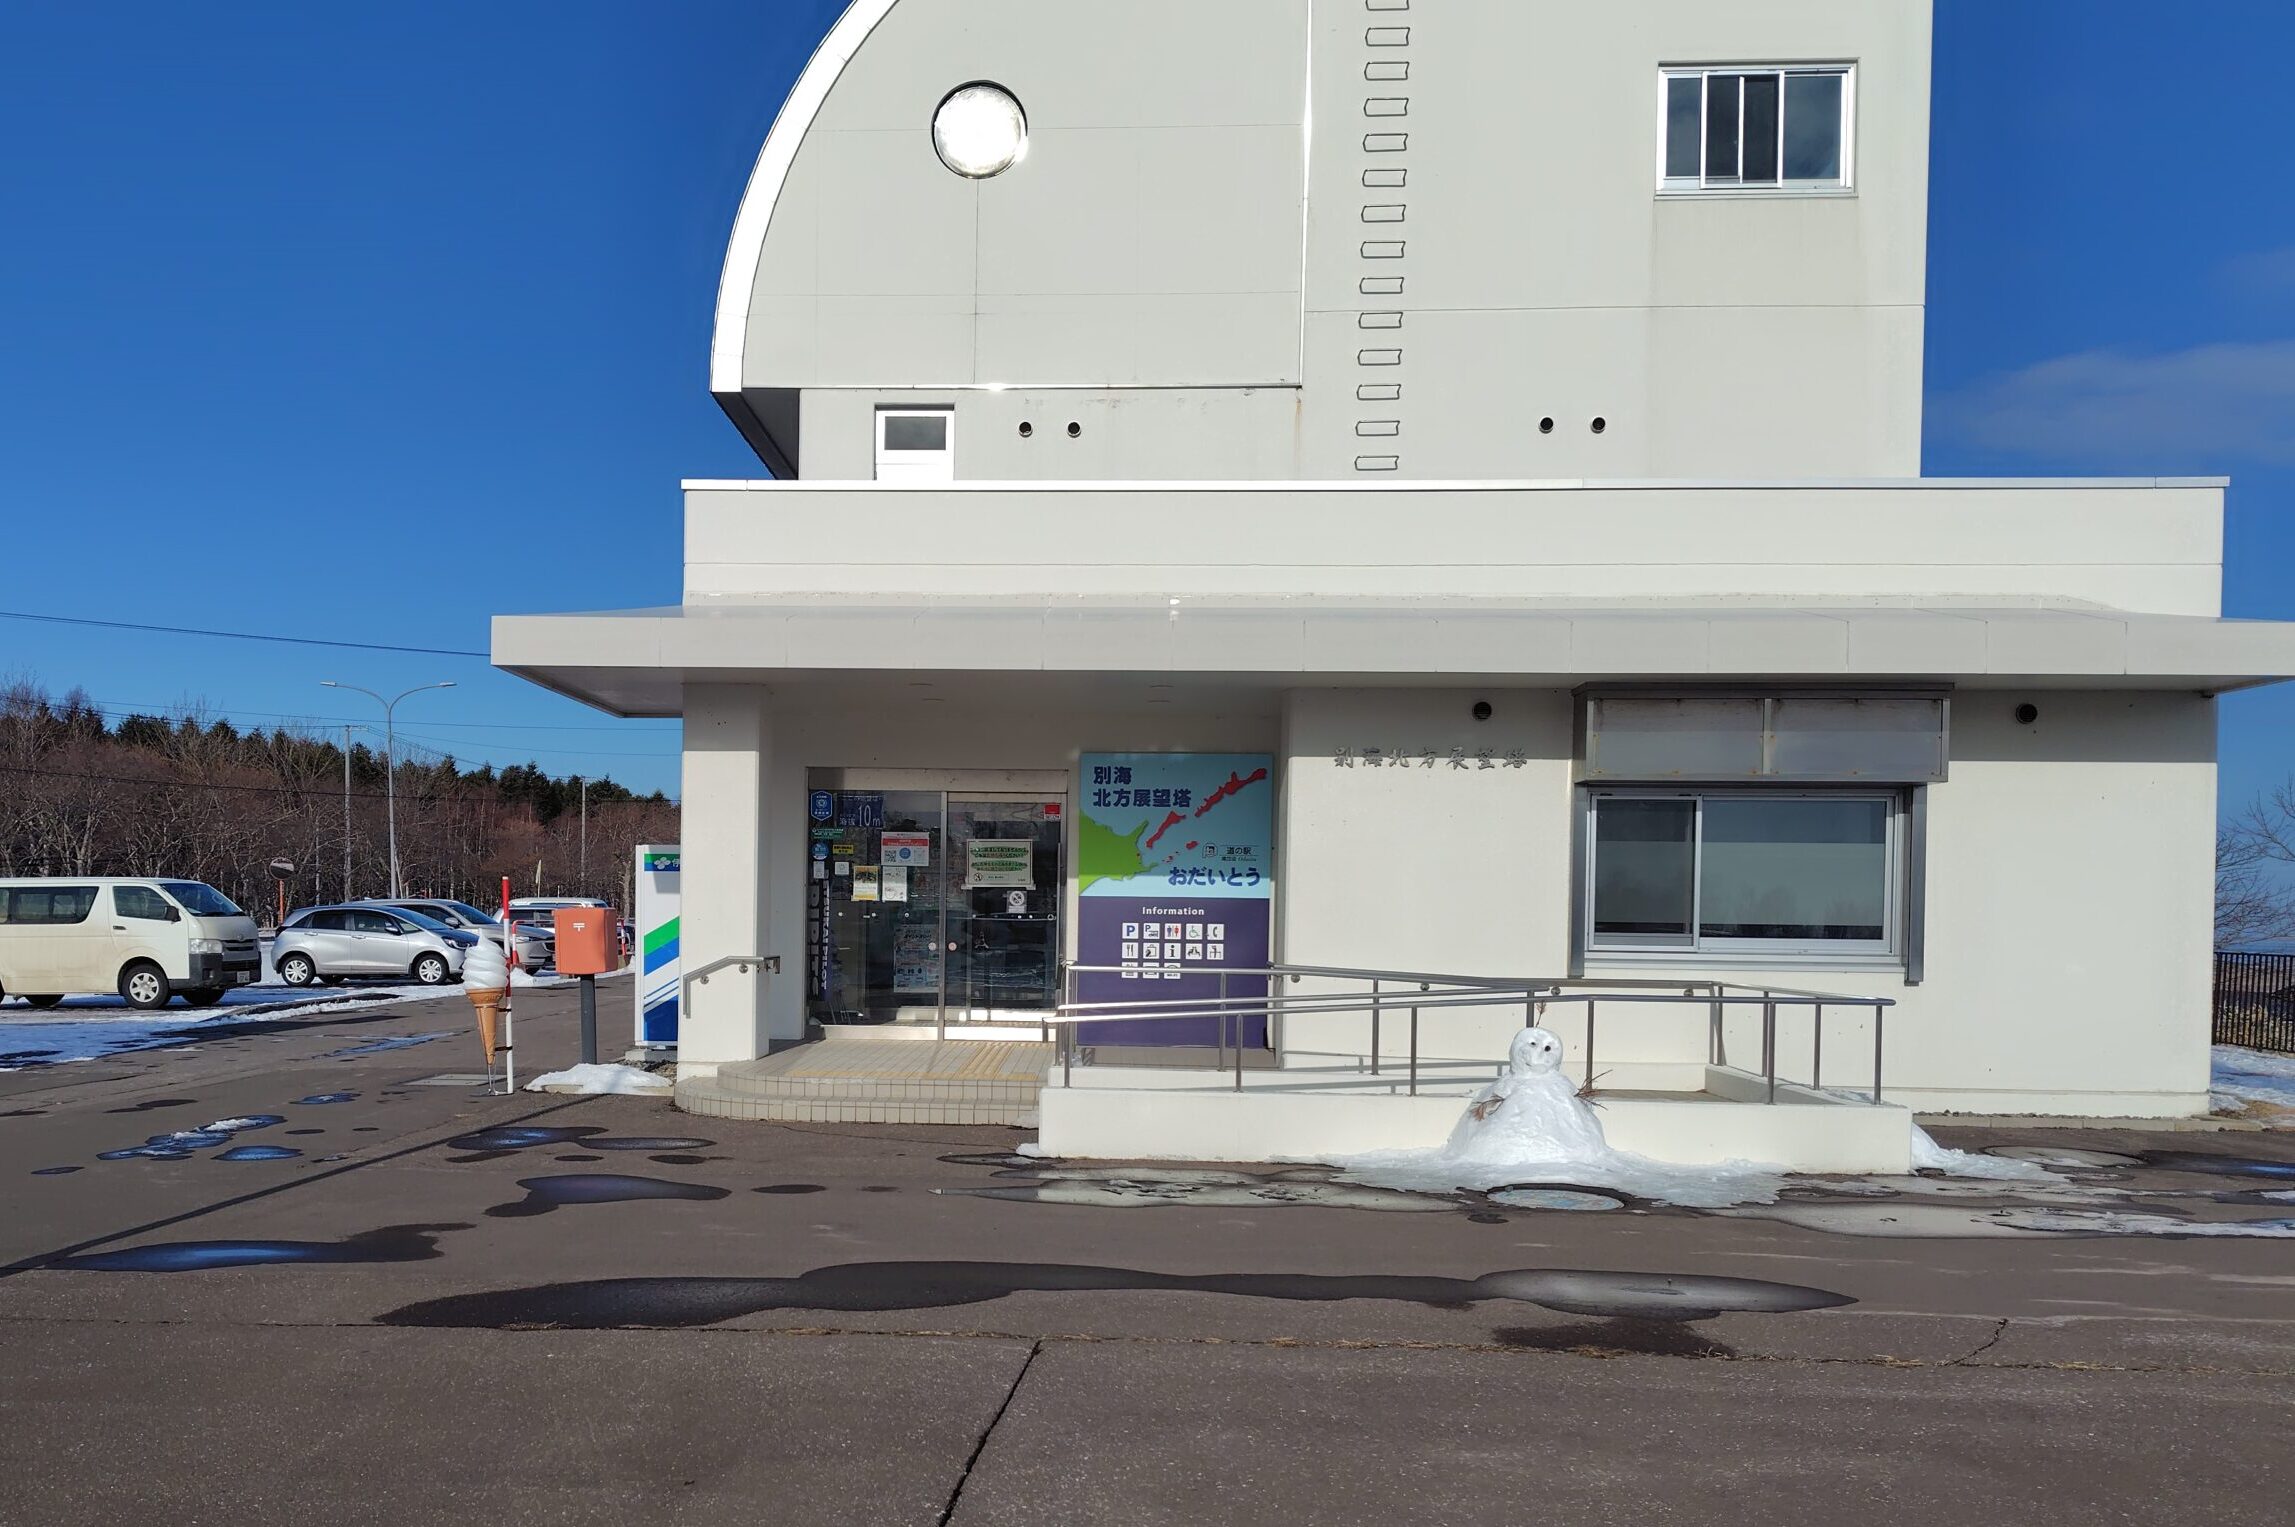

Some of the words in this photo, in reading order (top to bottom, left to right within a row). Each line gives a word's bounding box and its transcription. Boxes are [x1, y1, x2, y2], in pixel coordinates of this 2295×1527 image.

[1093, 766, 1132, 785] 別海
[1093, 788, 1192, 808] 北方展望塔
[1168, 867, 1261, 886] おだいとう
[1142, 906, 1205, 916] Information
